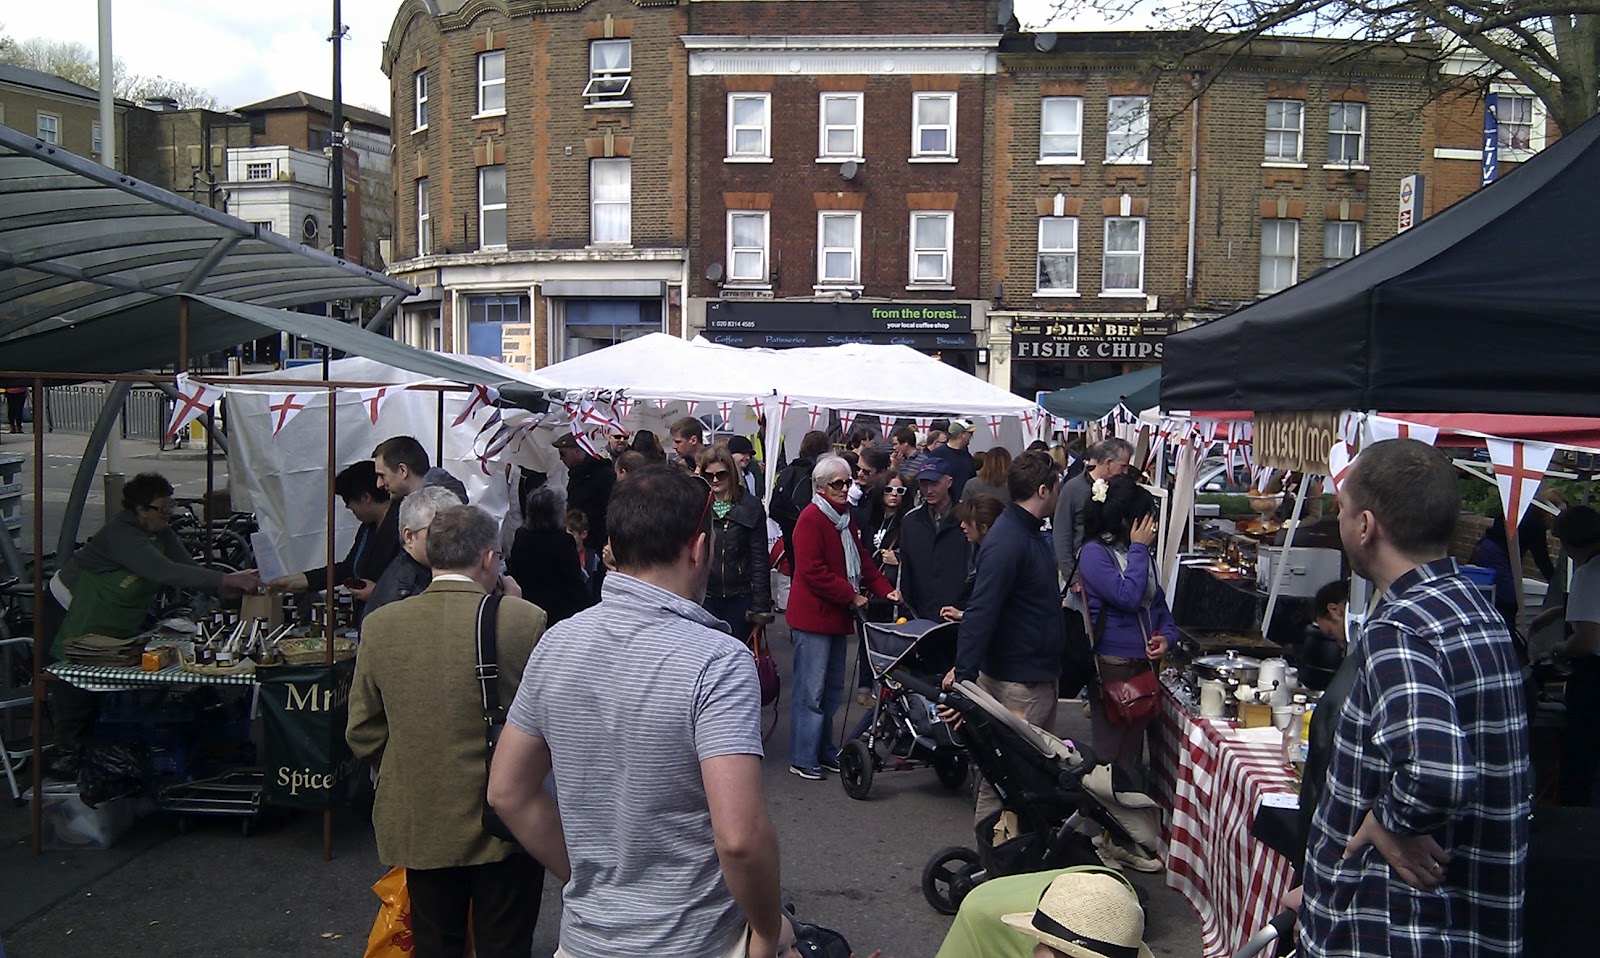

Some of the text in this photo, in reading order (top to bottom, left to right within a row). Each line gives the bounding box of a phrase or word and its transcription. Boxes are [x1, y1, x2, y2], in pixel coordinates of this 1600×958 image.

[872, 308, 899, 319] from
[901, 308, 920, 319] the
[714, 335, 743, 344] Coffees
[765, 335, 806, 343] Patisseries
[827, 336, 873, 344] Sandwiches
[1017, 342, 1164, 358] FISH & CHIPS
